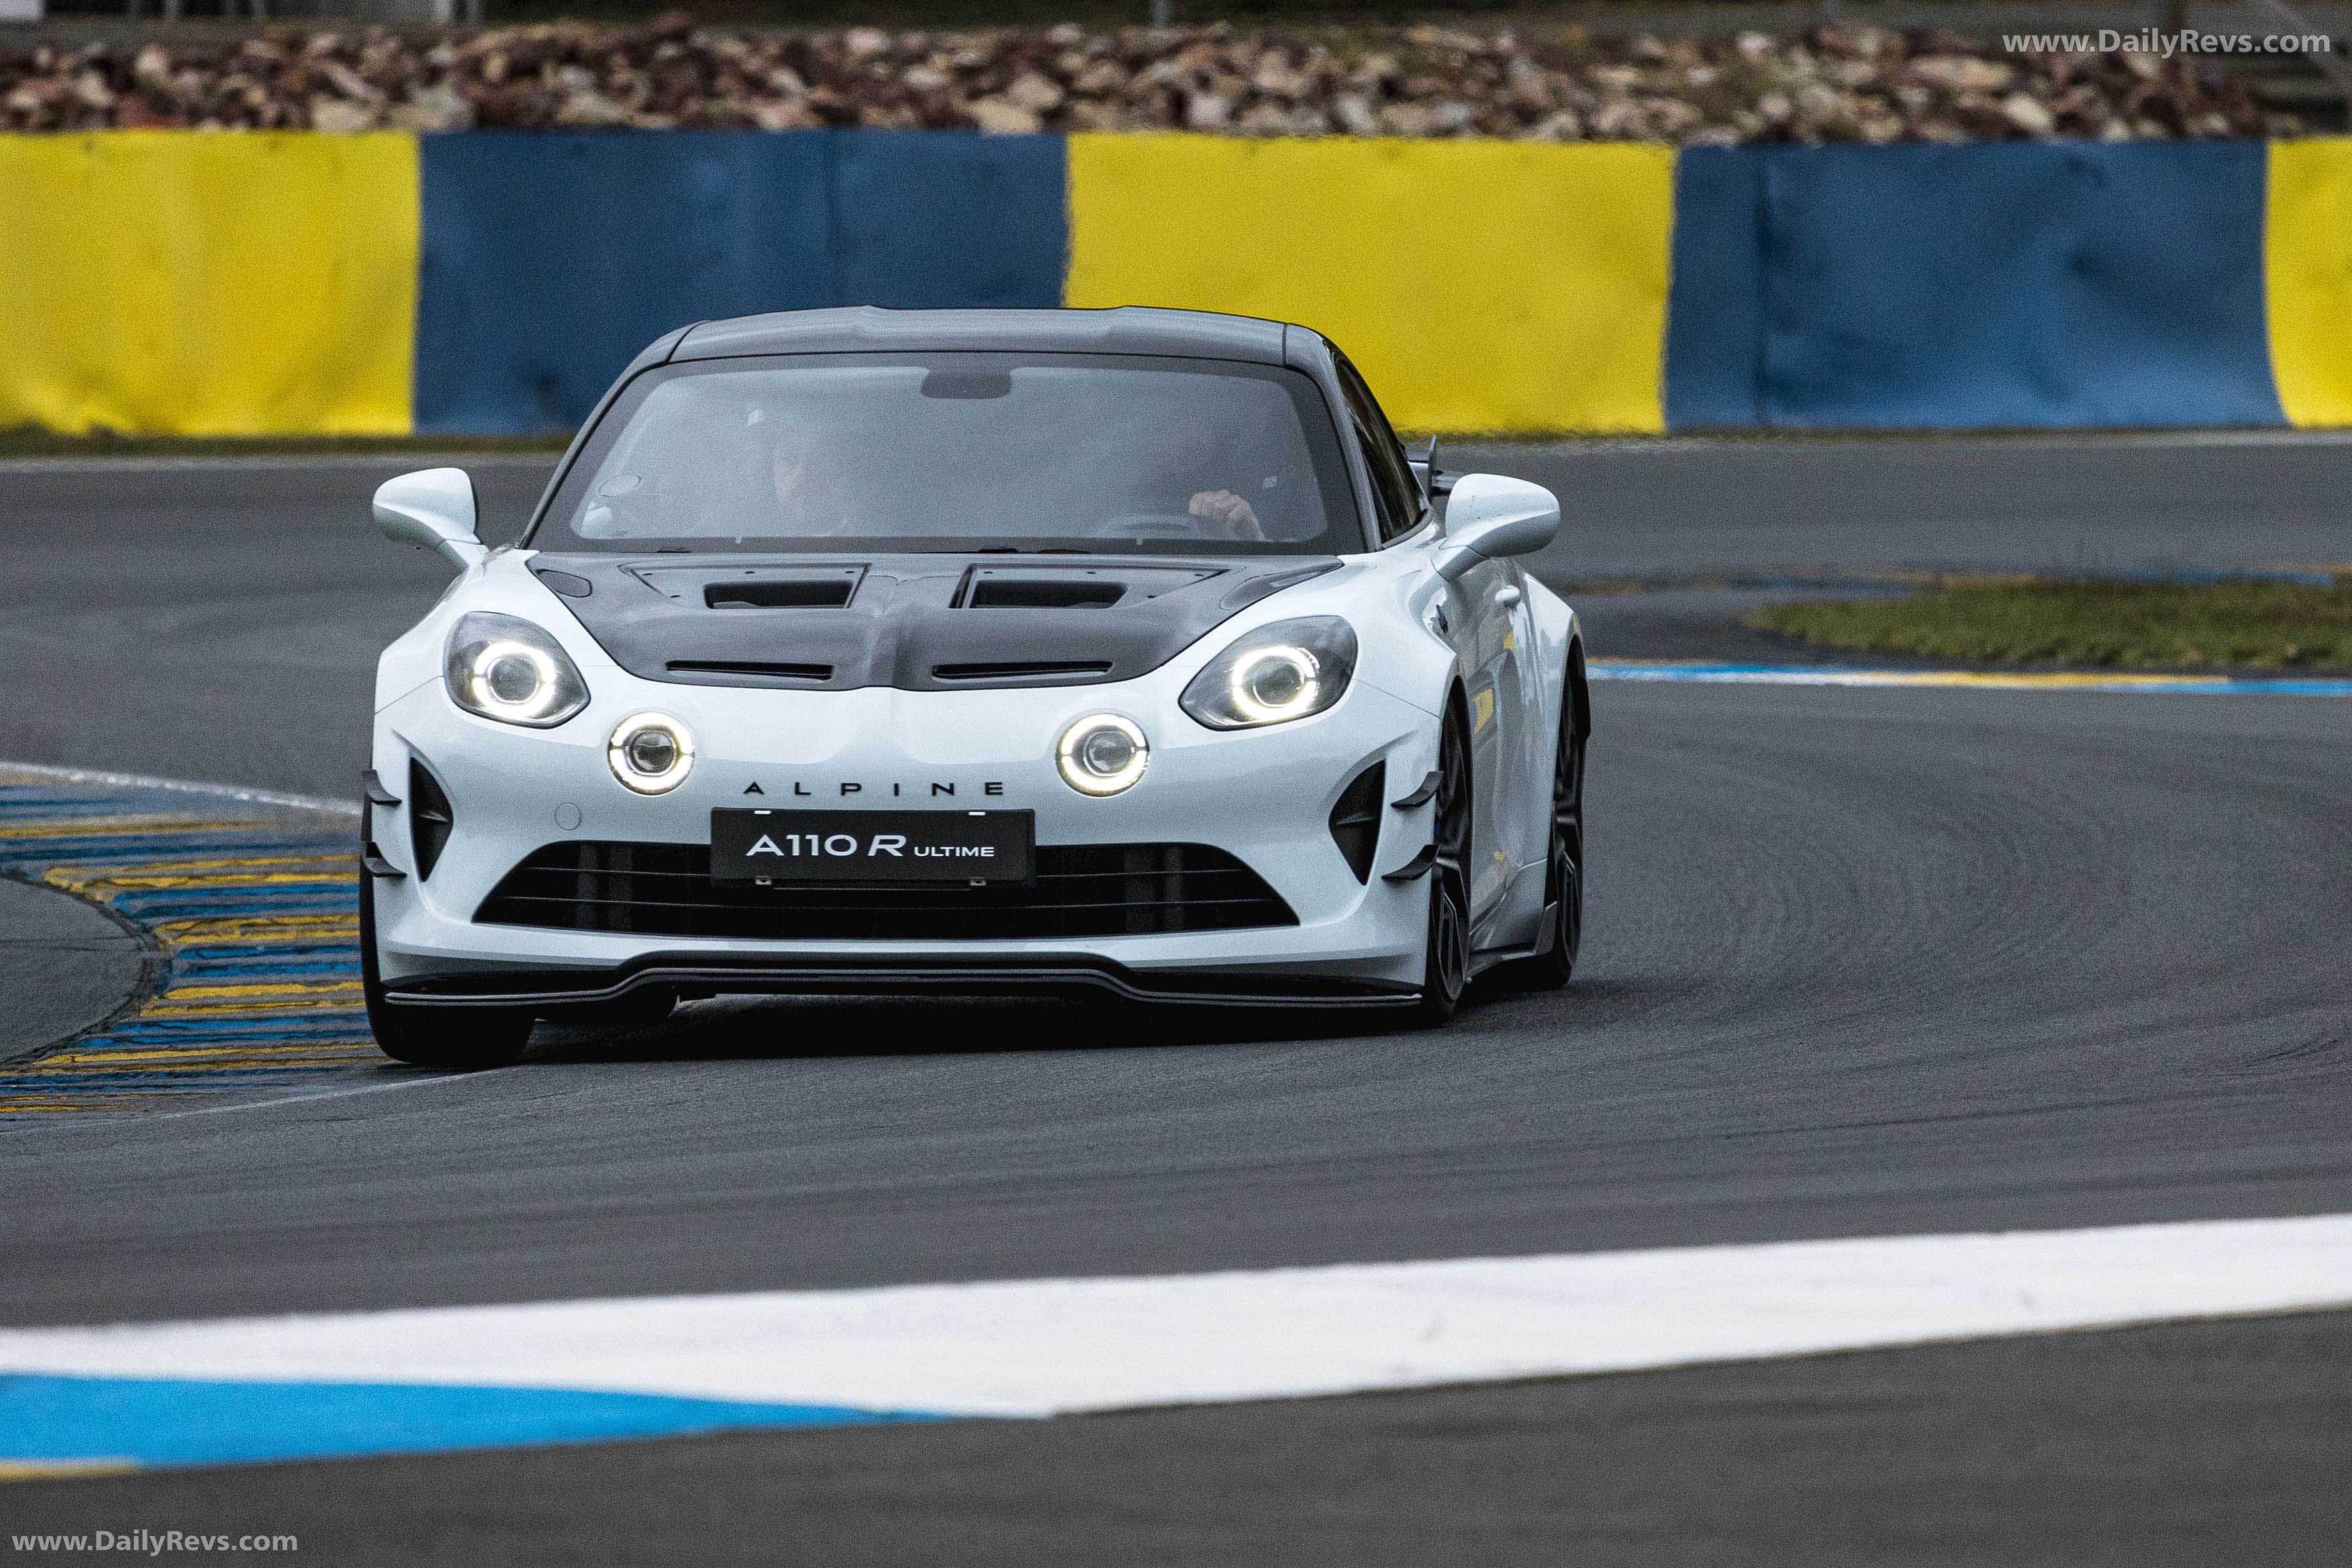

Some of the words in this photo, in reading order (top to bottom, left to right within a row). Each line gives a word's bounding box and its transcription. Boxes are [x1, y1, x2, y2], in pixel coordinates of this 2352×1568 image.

[743, 781, 1003, 796] ALPINE
[746, 834, 858, 856] A110
[868, 835, 907, 857] R
[914, 846, 995, 857] ULTIME
